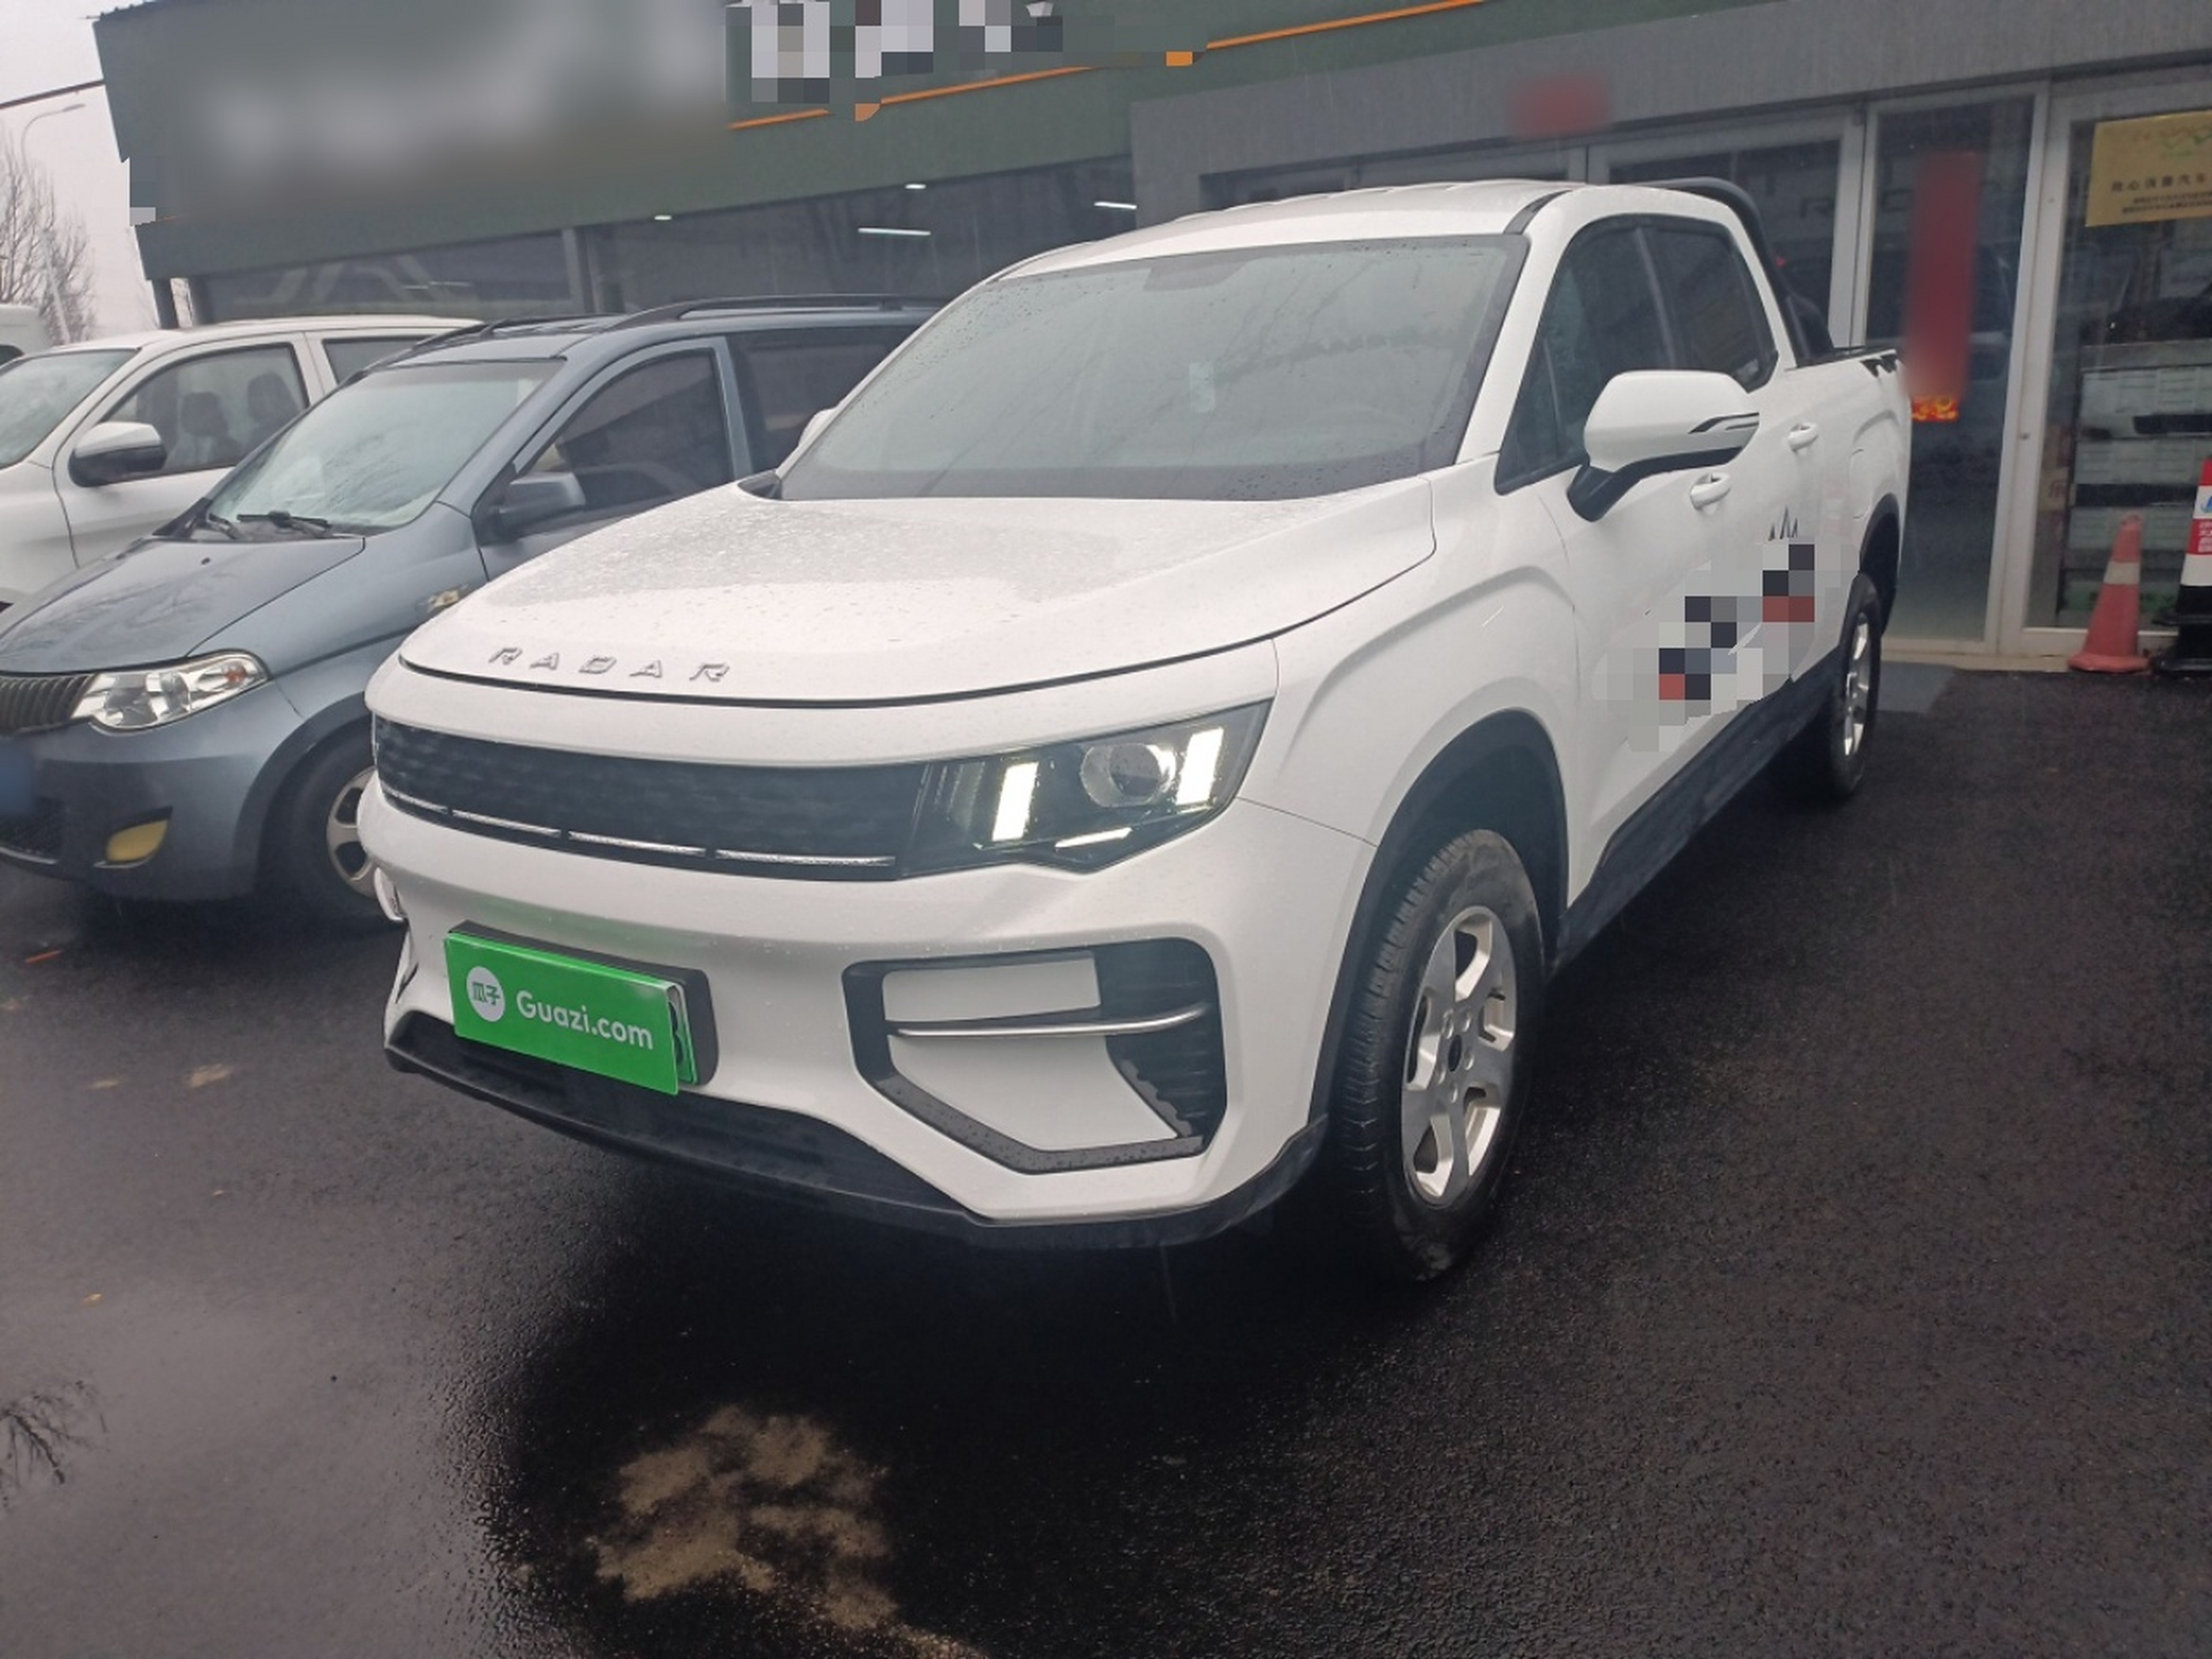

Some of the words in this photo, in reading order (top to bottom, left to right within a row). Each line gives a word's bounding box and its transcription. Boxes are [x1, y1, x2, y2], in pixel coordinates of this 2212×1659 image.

[488, 647, 730, 682] RADAR
[471, 980, 501, 1006] 瓜子
[516, 990, 653, 1050] Guazi.com
